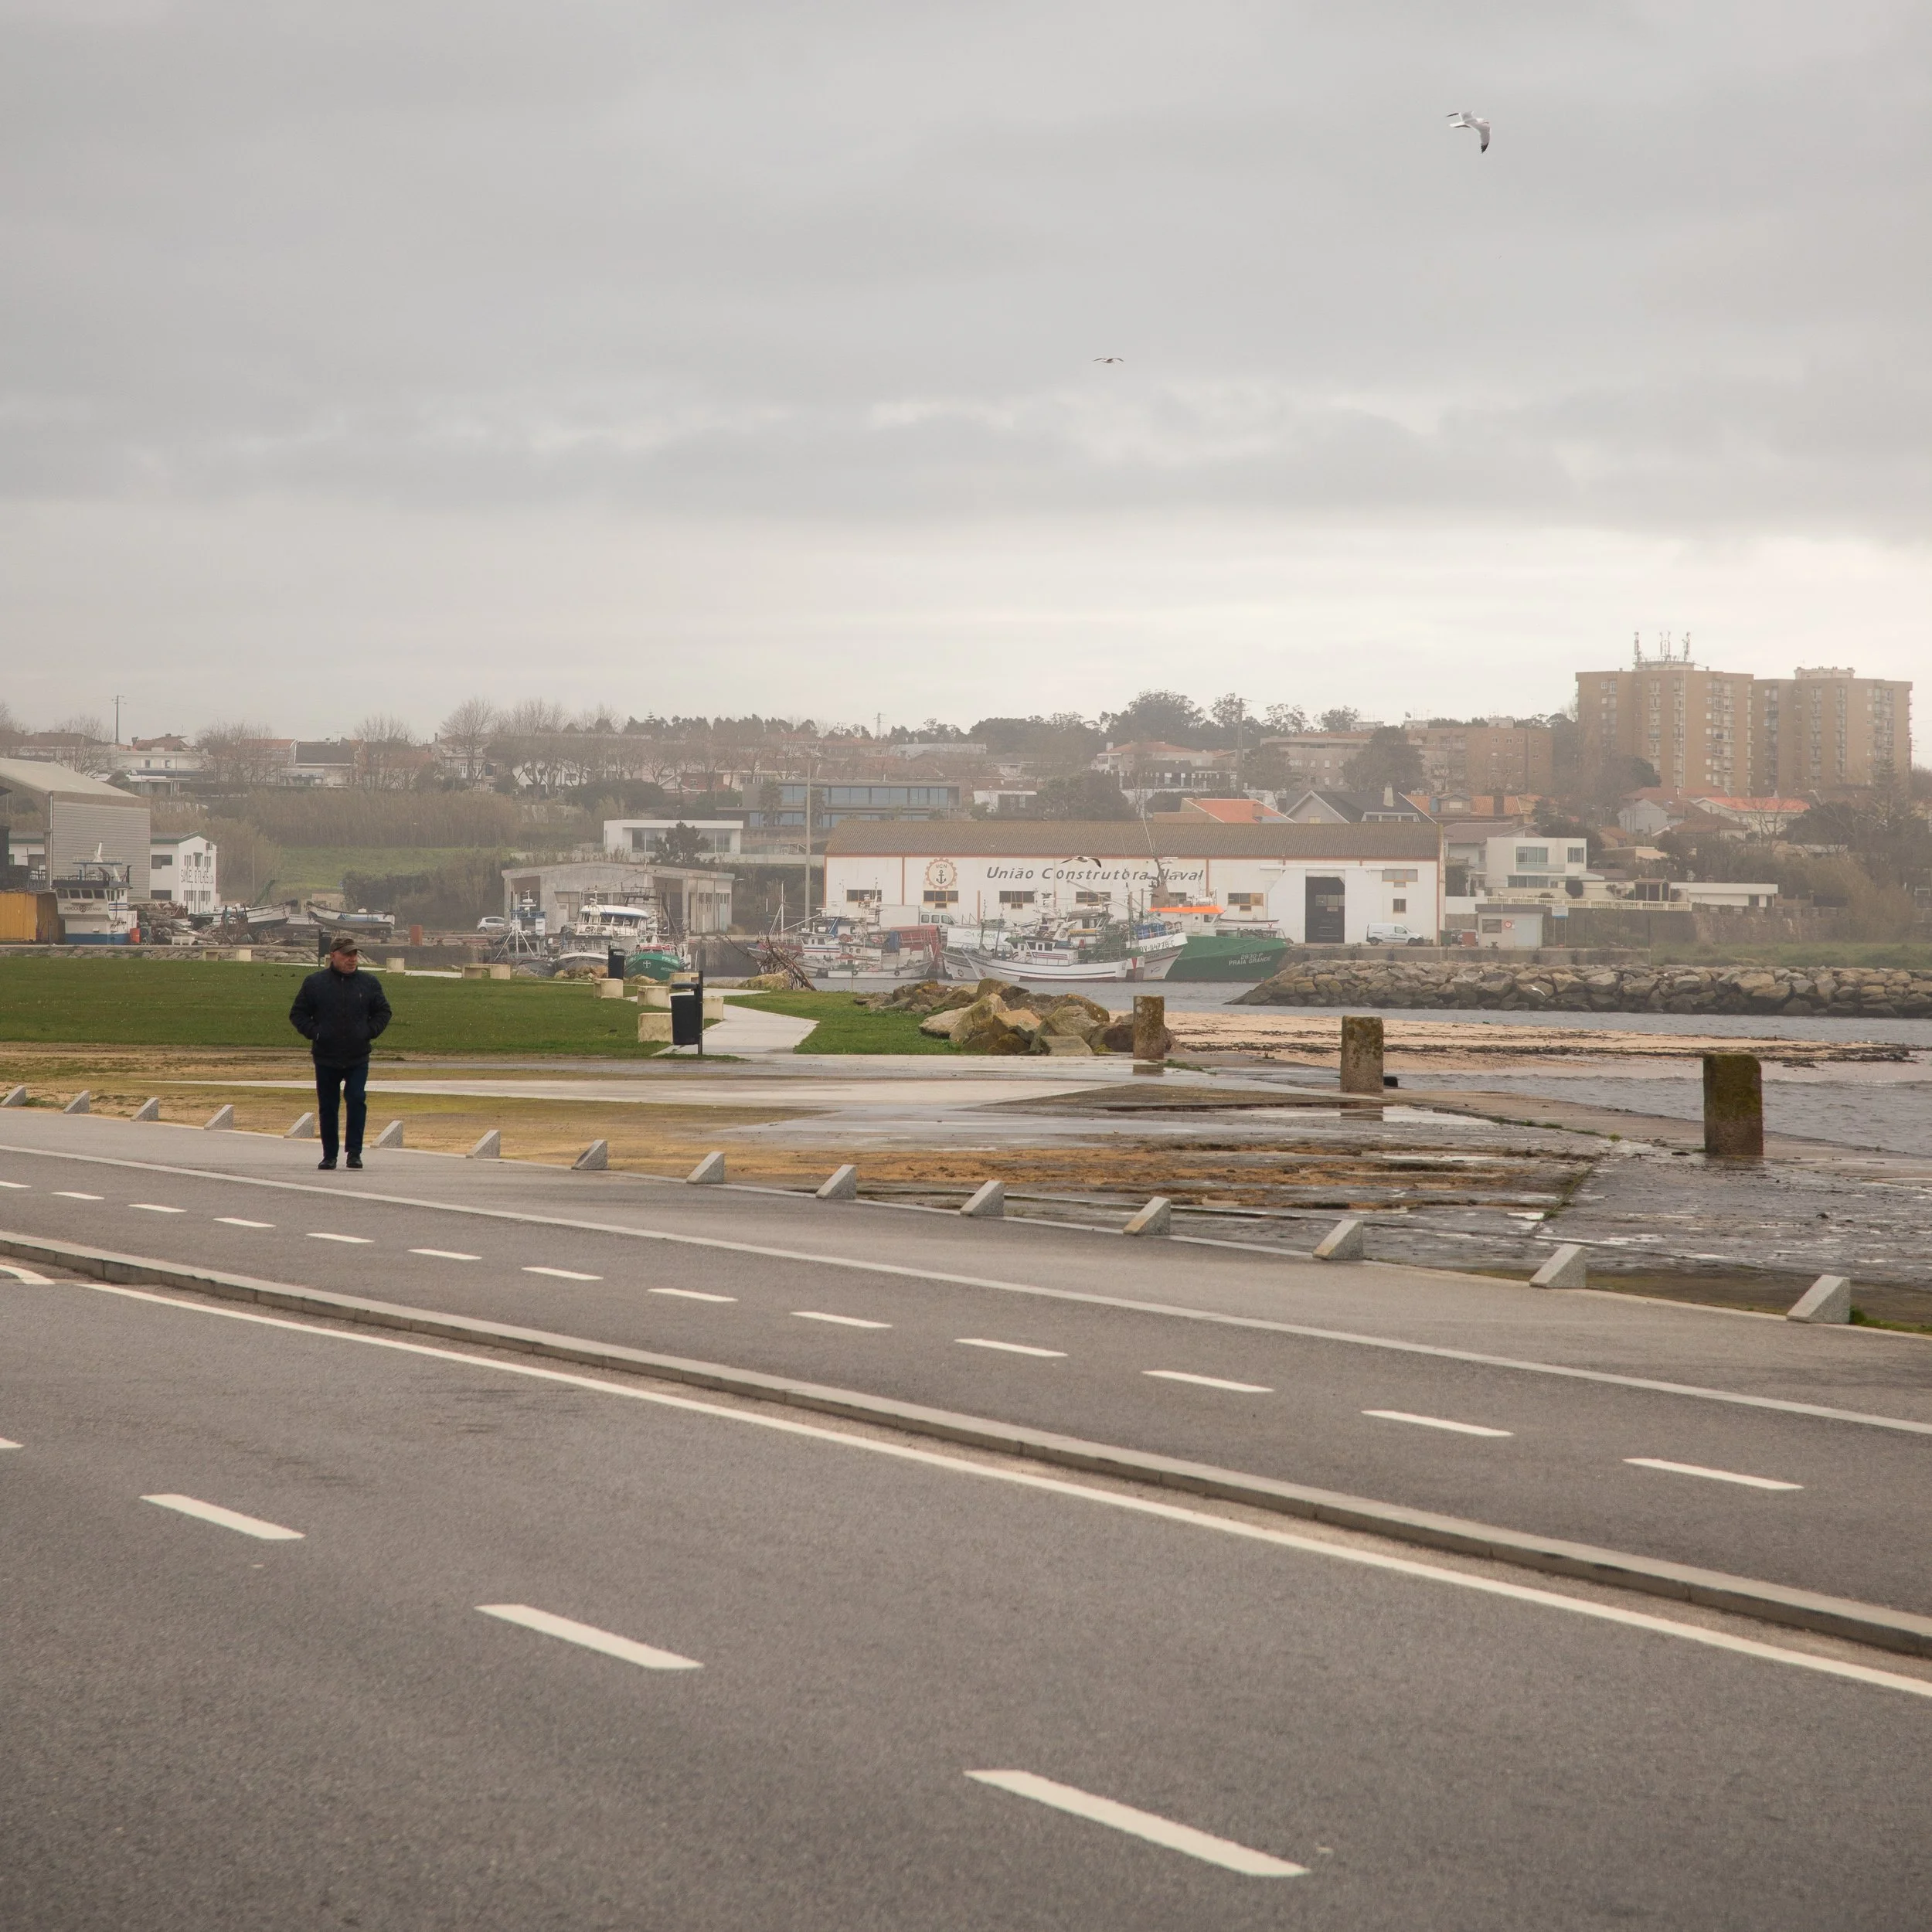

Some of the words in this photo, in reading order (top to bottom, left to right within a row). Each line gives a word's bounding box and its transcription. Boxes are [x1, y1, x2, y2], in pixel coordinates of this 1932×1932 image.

[986, 866, 1034, 879] União
[1041, 868, 1148, 880] Construtora
[1248, 955, 1272, 964] GRANDE
